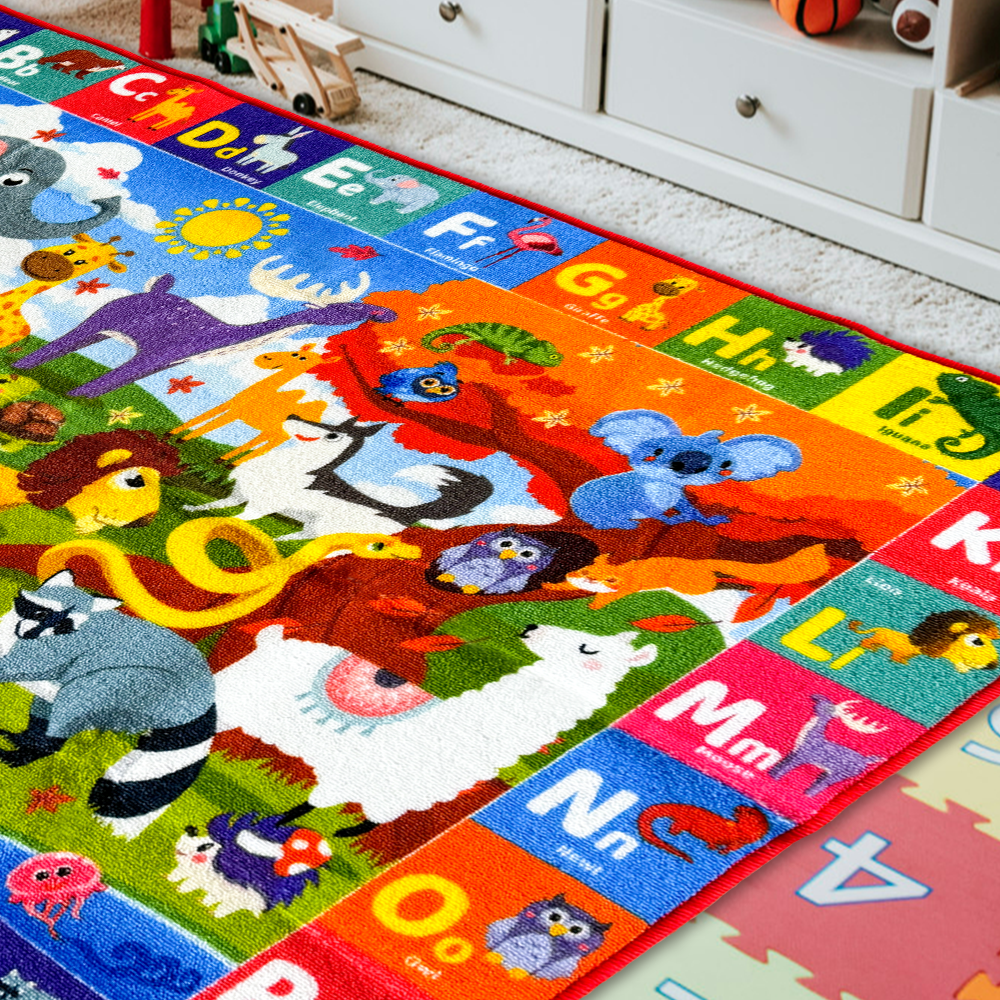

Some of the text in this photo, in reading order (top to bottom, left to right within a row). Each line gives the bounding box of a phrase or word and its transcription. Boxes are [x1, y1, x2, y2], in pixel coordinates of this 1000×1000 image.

[109, 72, 168, 103] Cc
[90, 112, 123, 127] Camel
[176, 120, 249, 160] Dd
[221, 166, 263, 186] Donkey
[302, 157, 374, 197] Ee
[306, 200, 358, 222] Elephant
[423, 211, 499, 250] Ff
[424, 247, 480, 273] Flamingo
[555, 262, 628, 311] Gg
[563, 302, 610, 325] Giraffe
[682, 314, 778, 372] Hh
[701, 357, 776, 392] Hedgehog
[877, 425, 932, 451] Iguana
[864, 575, 903, 597] Lion
[947, 576, 1000, 602] Koala
[653, 679, 782, 772] Mm
[694, 745, 756, 780] Moose
[525, 768, 640, 861] Nn
[555, 843, 604, 876] Newt
[794, 829, 934, 907] 4
[371, 873, 475, 964] Oo
